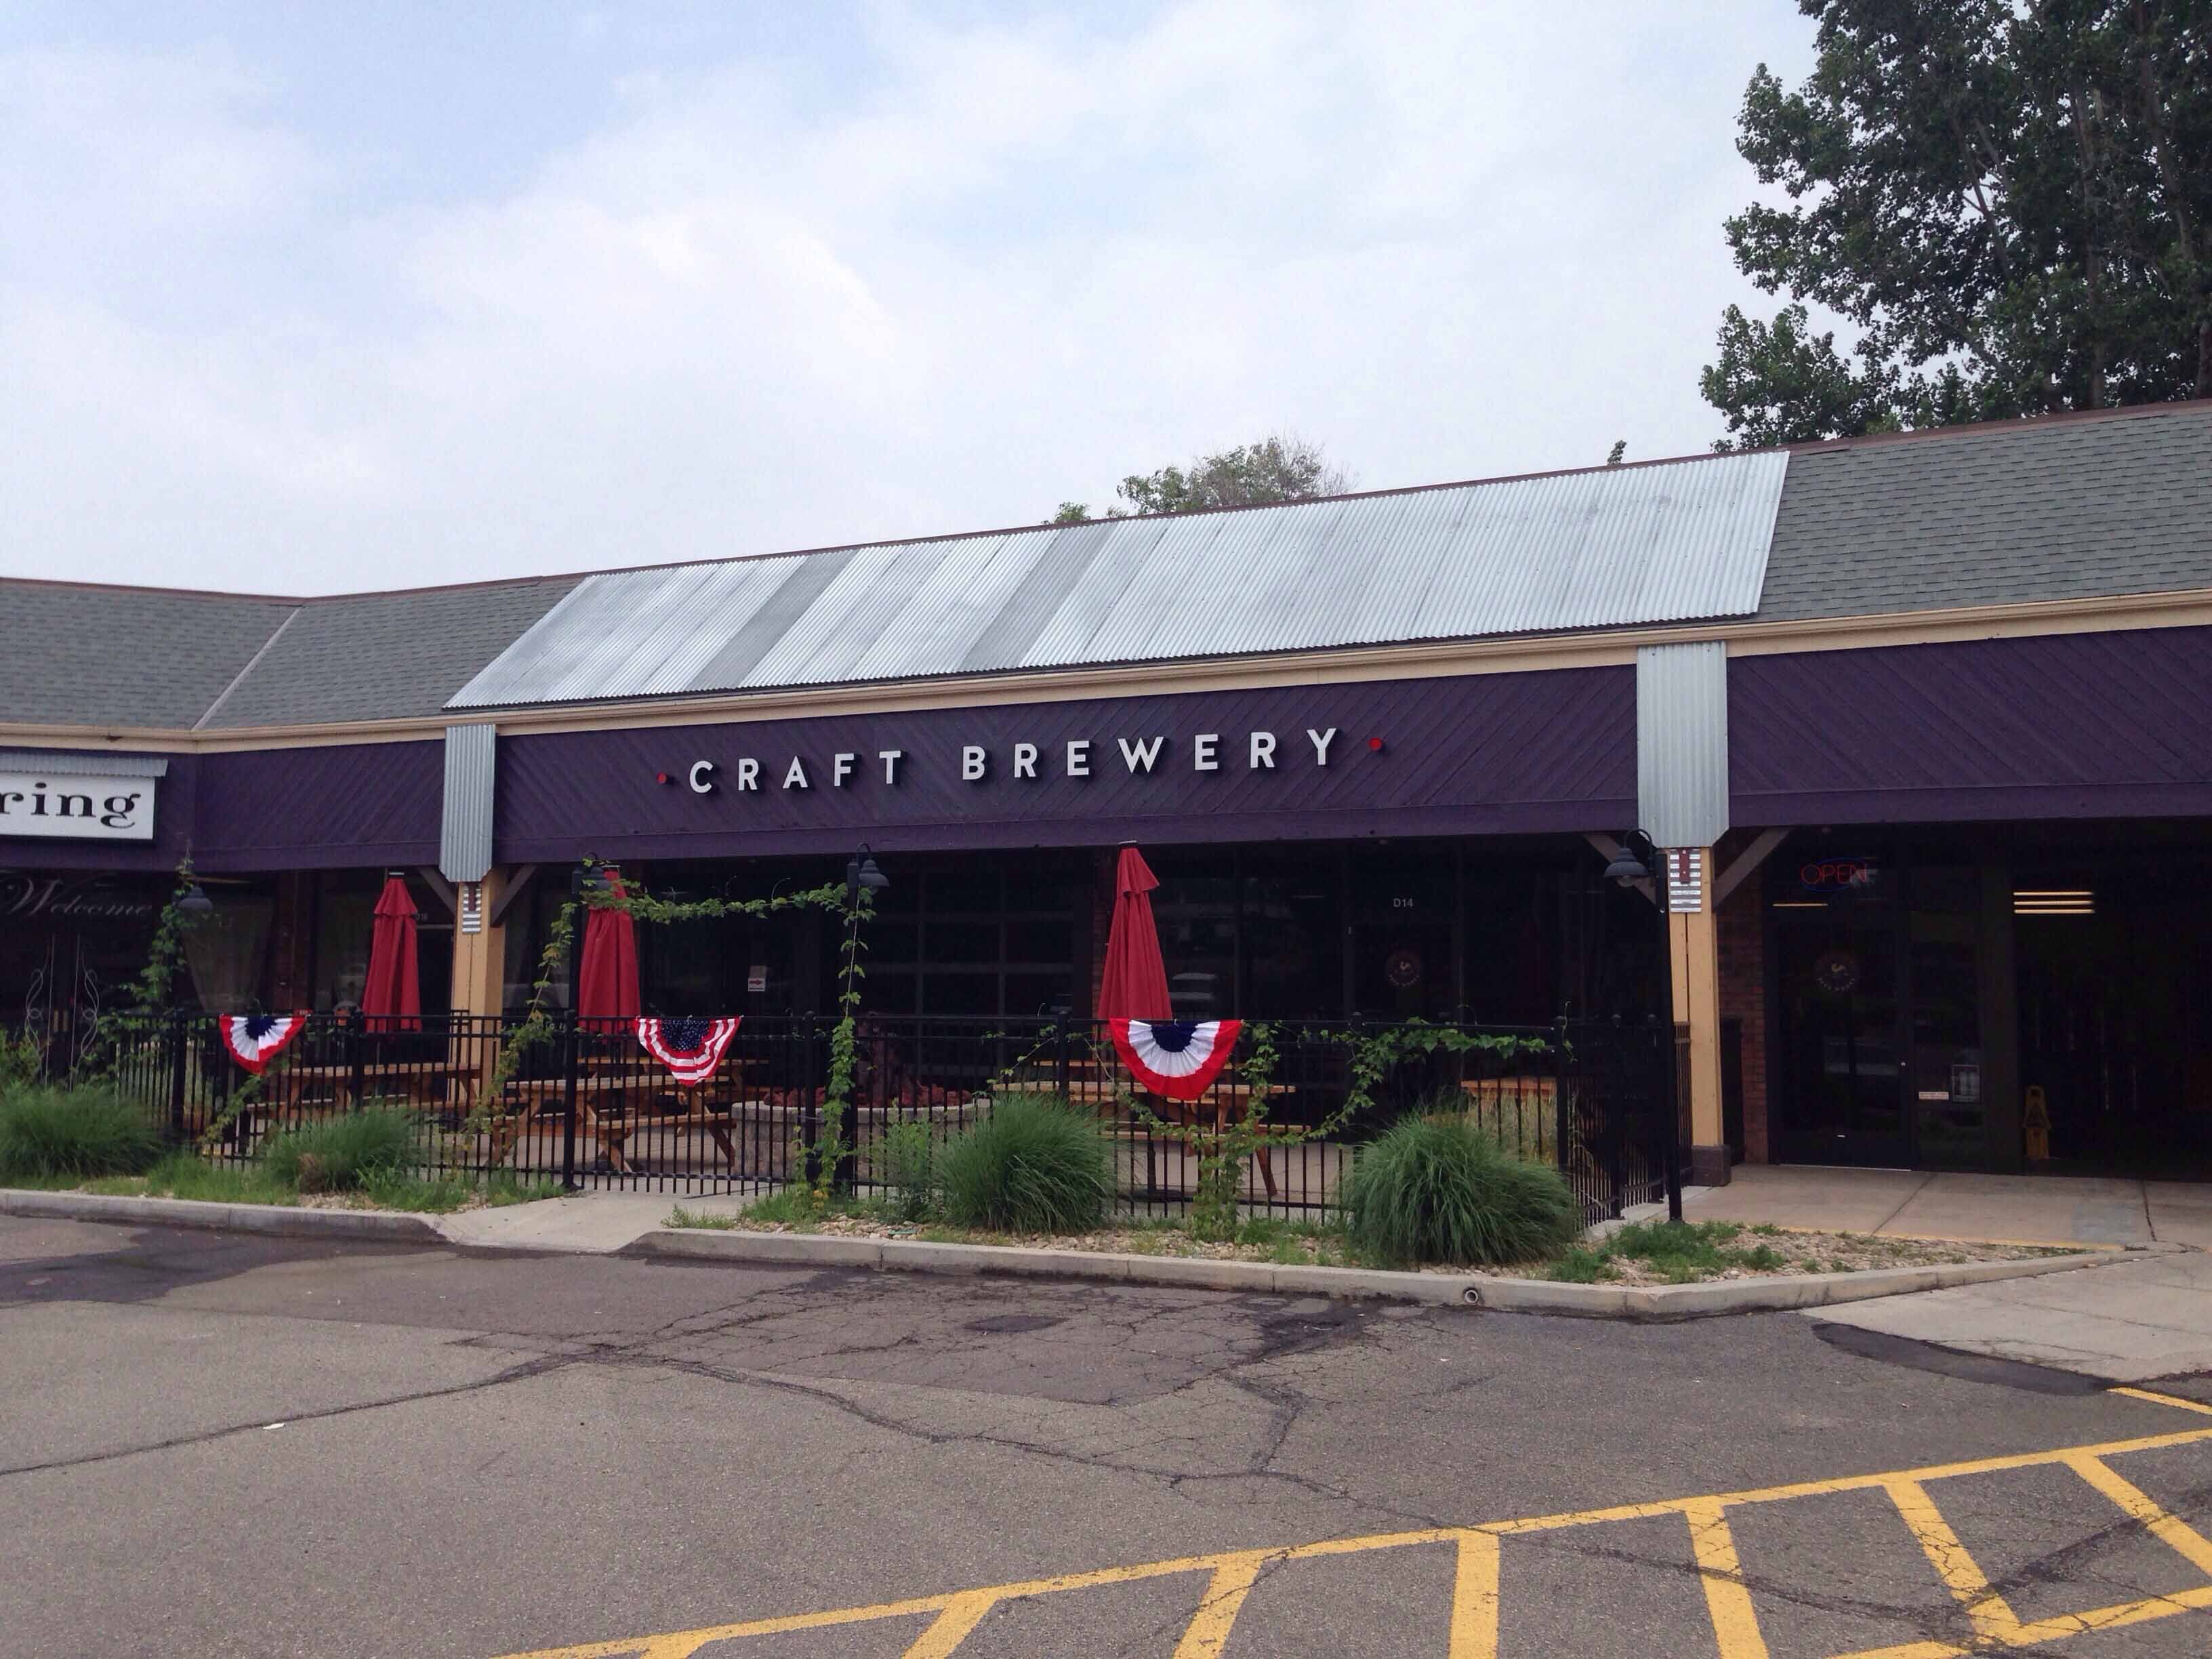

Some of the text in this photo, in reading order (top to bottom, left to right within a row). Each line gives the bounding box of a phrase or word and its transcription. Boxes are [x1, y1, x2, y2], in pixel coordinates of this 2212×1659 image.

[689, 727, 1336, 794] CRAFT BREWERY
[0, 782, 141, 829] ring
[1800, 862, 1866, 884] OPEN
[5, 878, 153, 917] Welcome
[1393, 898, 1414, 907] D14
